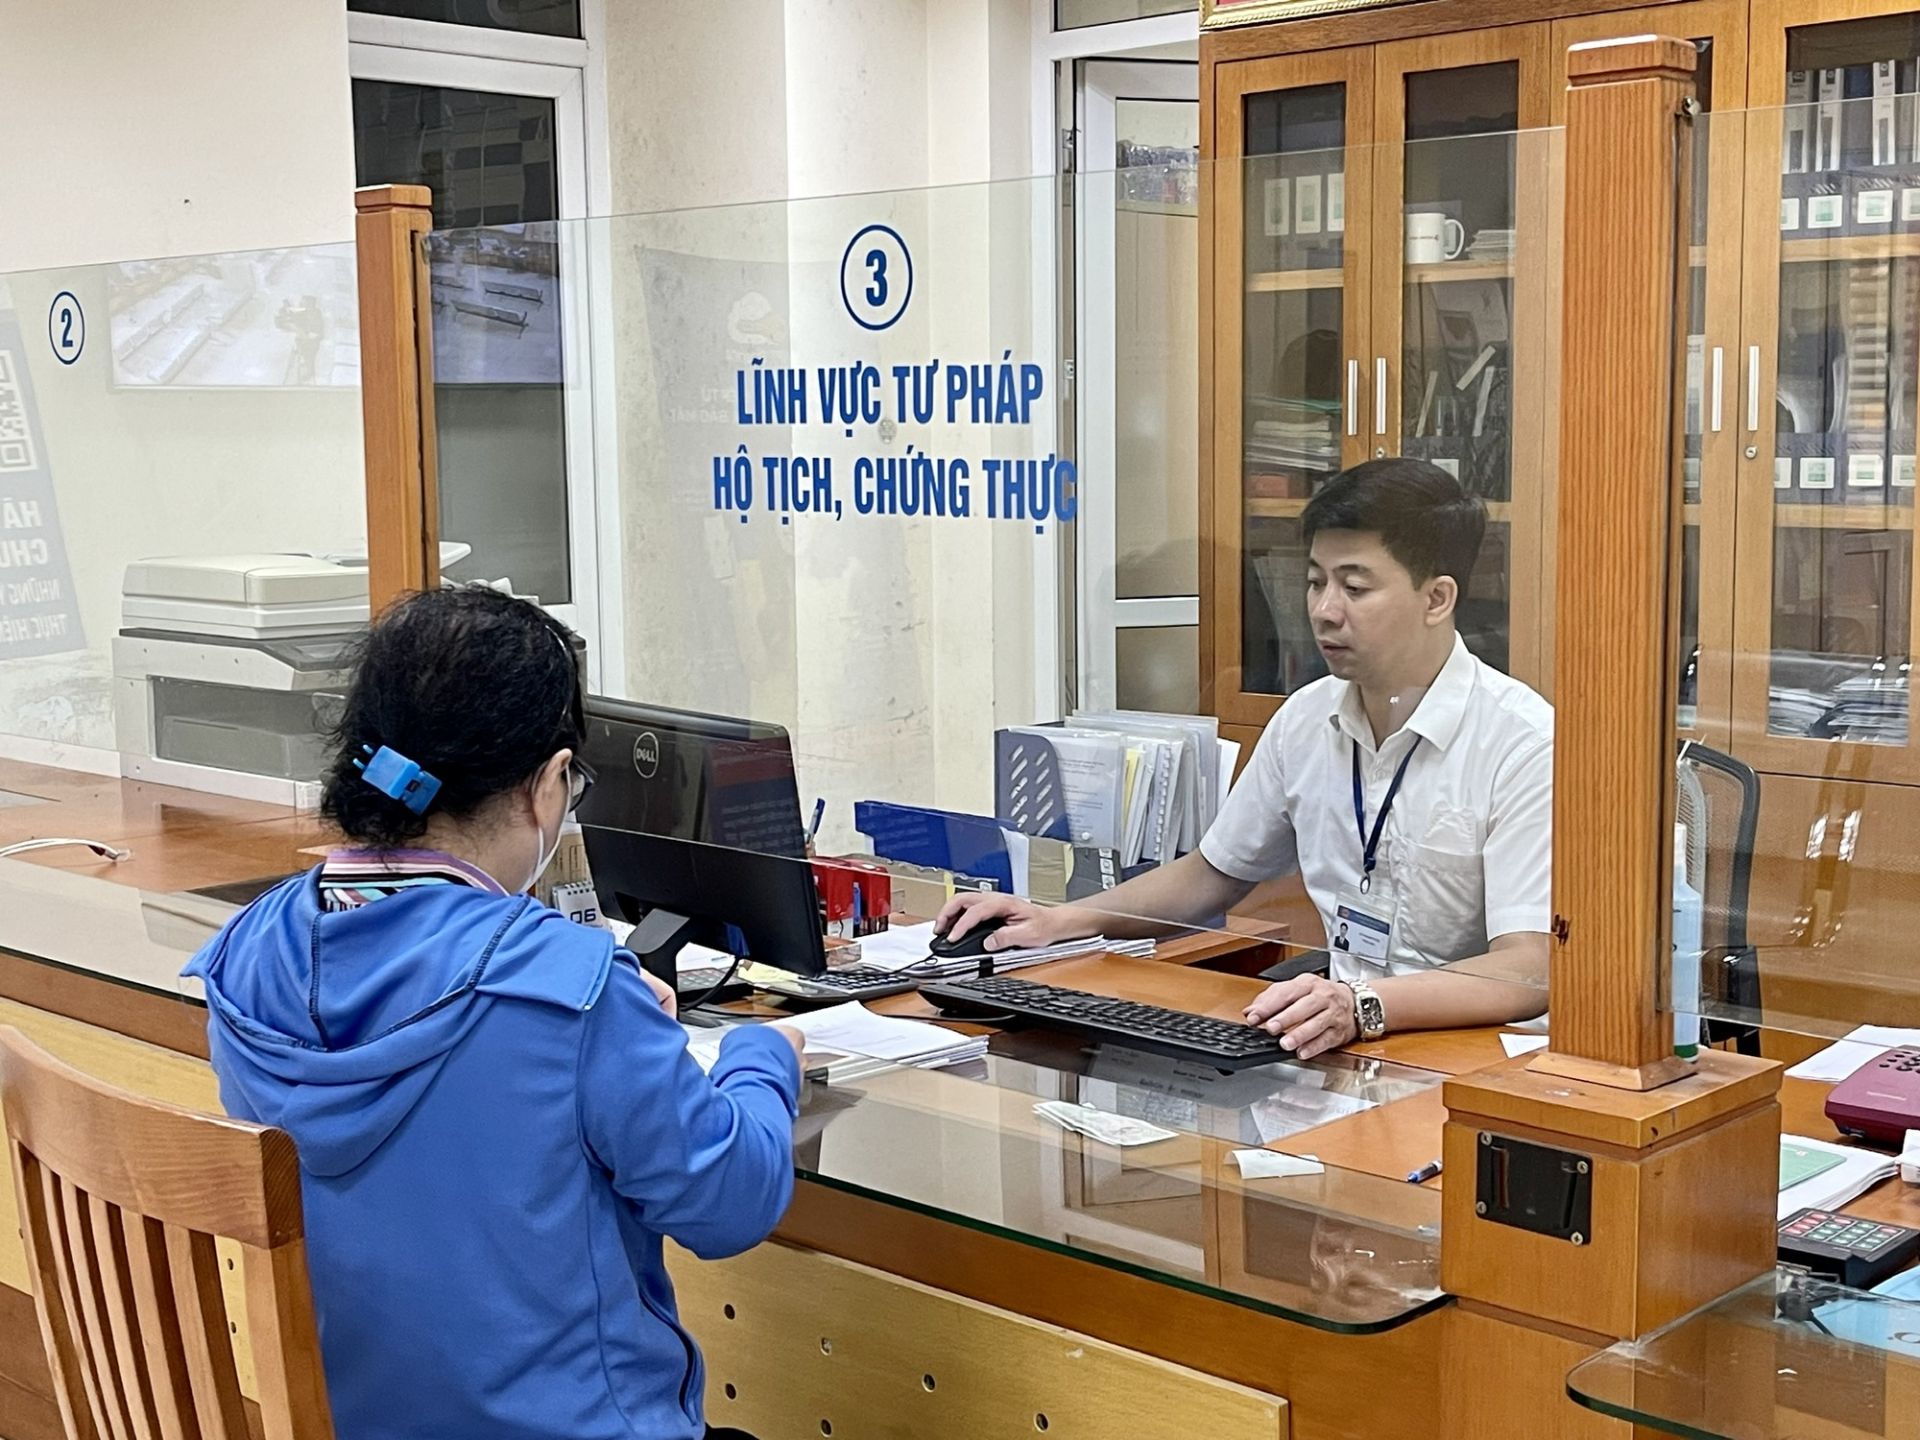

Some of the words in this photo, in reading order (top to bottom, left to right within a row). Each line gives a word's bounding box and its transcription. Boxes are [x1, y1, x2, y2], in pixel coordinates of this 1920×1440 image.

[865, 249, 889, 307] 3
[61, 308, 74, 347] 2
[737, 357, 807, 425] LĨNH
[817, 360, 882, 438] VỰC
[892, 359, 939, 425] TƯ
[946, 350, 1044, 425] PHÁP
[712, 444, 753, 524] HỘ
[762, 456, 842, 525] TỊCH,
[853, 444, 971, 518] CHỨNG
[982, 453, 1079, 535] THỰC
[636, 748, 656, 762] DELL
[570, 908, 597, 924] 06
